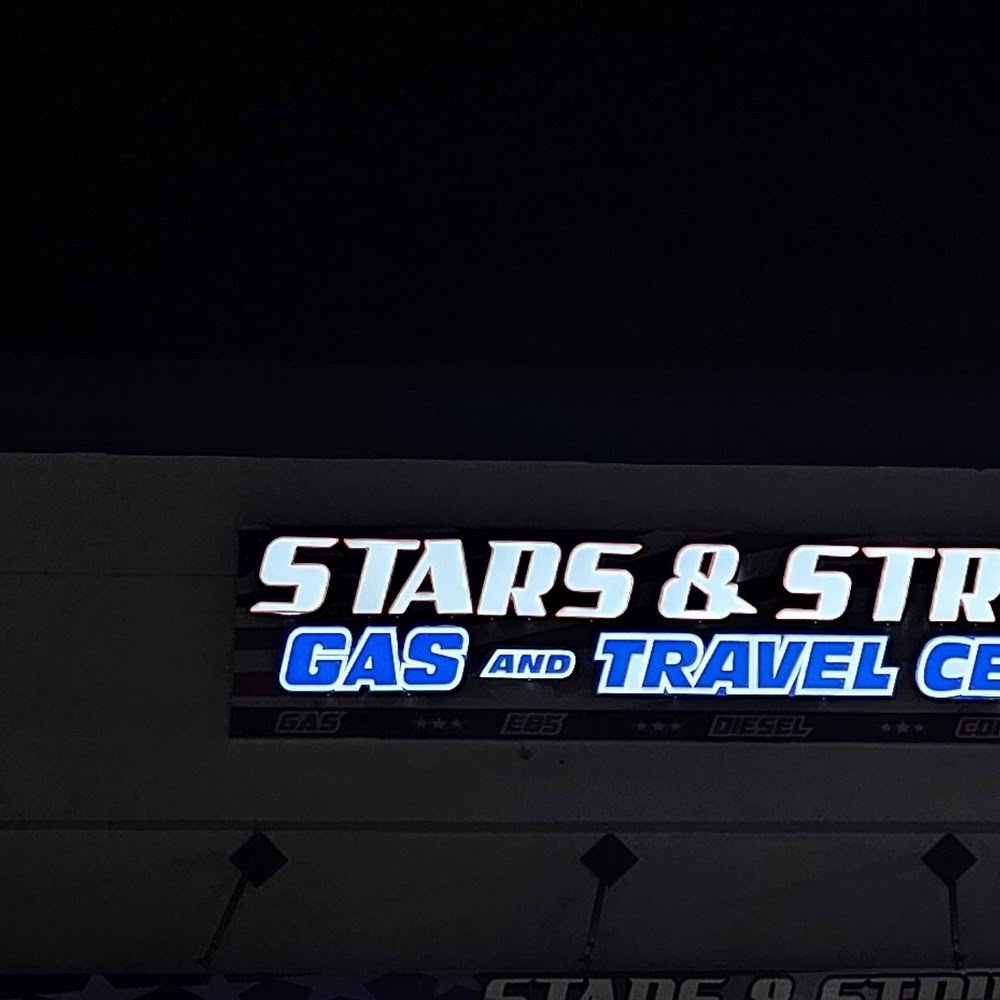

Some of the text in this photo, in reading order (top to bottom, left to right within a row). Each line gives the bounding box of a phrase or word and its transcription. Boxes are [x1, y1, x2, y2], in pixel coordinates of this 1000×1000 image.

[250, 536, 643, 618] STARS
[658, 543, 758, 619] &
[279, 626, 470, 692] GAS
[481, 649, 576, 679] AND
[596, 632, 899, 697] TRAVEL
[275, 711, 346, 733] GAS
[708, 715, 814, 738] DIESEL
